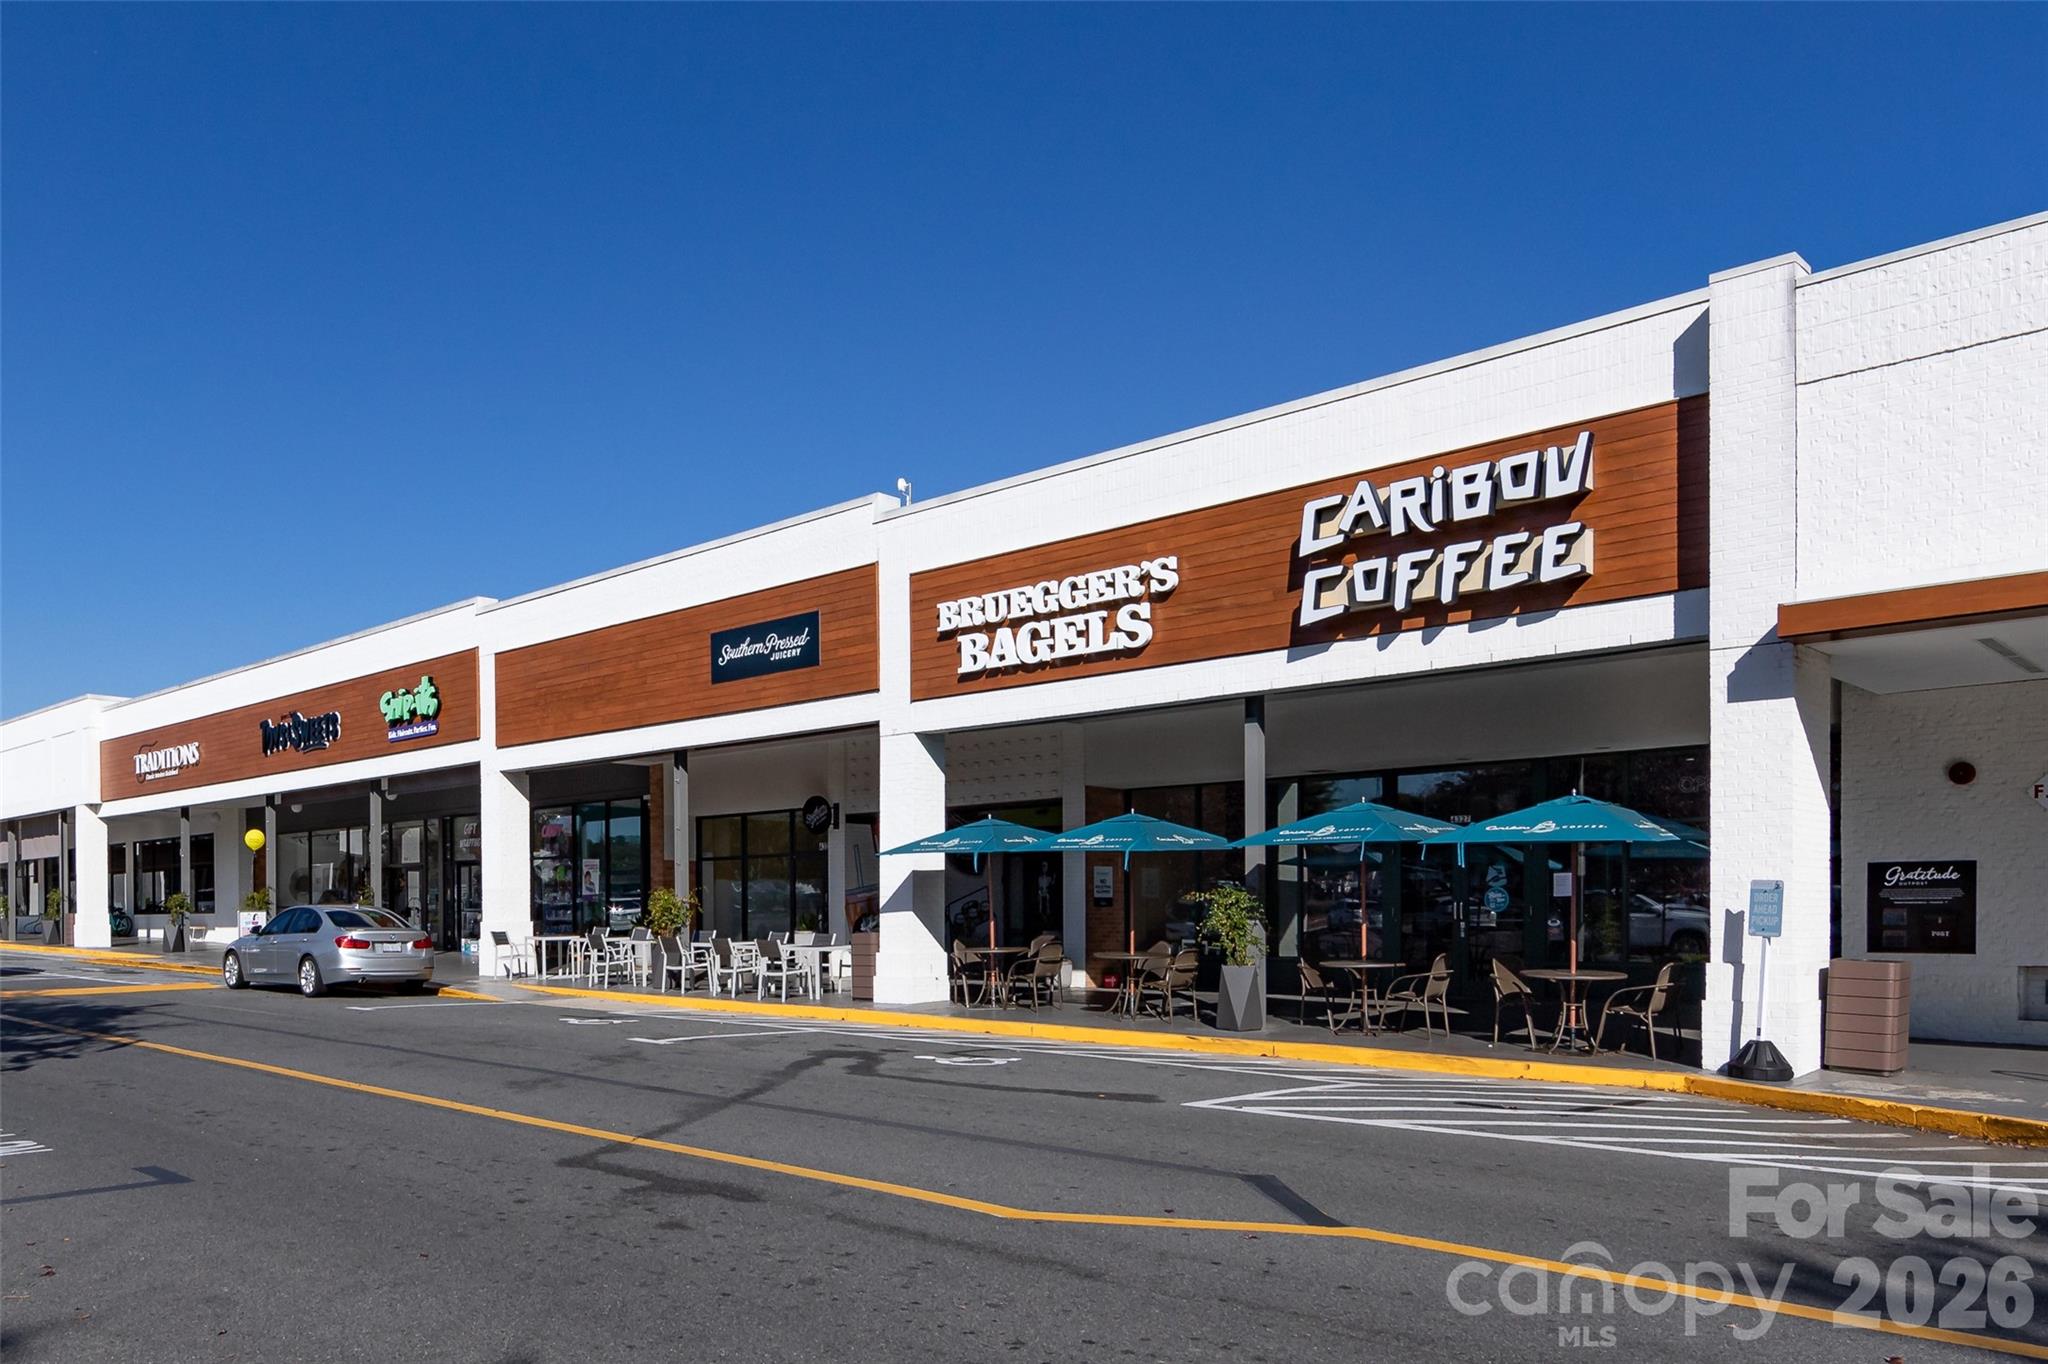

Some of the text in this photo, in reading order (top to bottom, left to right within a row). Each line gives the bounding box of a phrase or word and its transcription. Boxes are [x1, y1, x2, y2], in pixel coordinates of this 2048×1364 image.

[1299, 521, 1586, 626] COFFEE
[936, 555, 1180, 632] BRUEGGER'S
[718, 627, 810, 666] Southern Pressed
[957, 602, 1153, 674] BAGELS
[770, 647, 801, 661] JUICERY
[133, 742, 200, 774] TRADITIONS
[1884, 866, 1960, 886] Gratitude
[1753, 892, 1779, 903] ORDER
[1753, 904, 1778, 914] AHEAD
[1751, 915, 1779, 926] PICKUP
